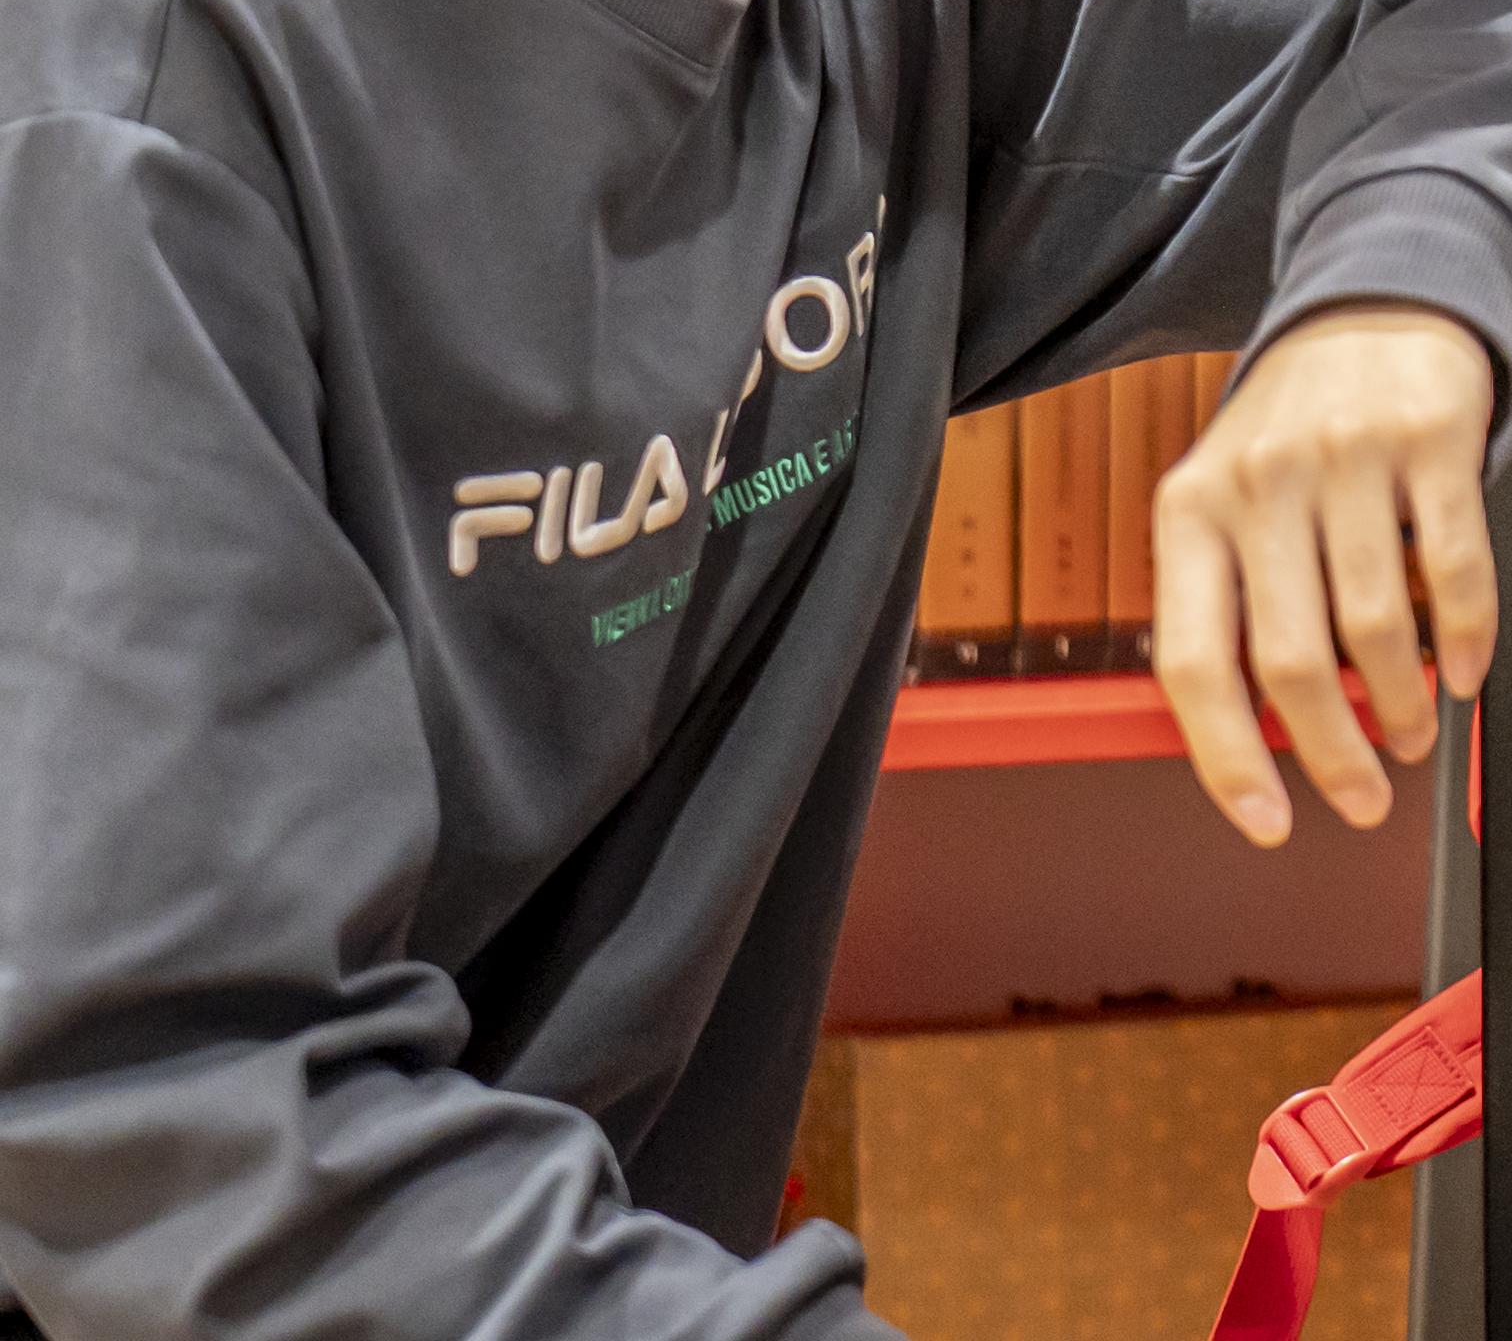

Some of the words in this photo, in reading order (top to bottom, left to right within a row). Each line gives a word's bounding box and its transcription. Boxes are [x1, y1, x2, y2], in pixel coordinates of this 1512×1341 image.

[448, 434, 689, 577] FILA
[711, 450, 809, 531] MUSICA
[812, 438, 832, 475] E
